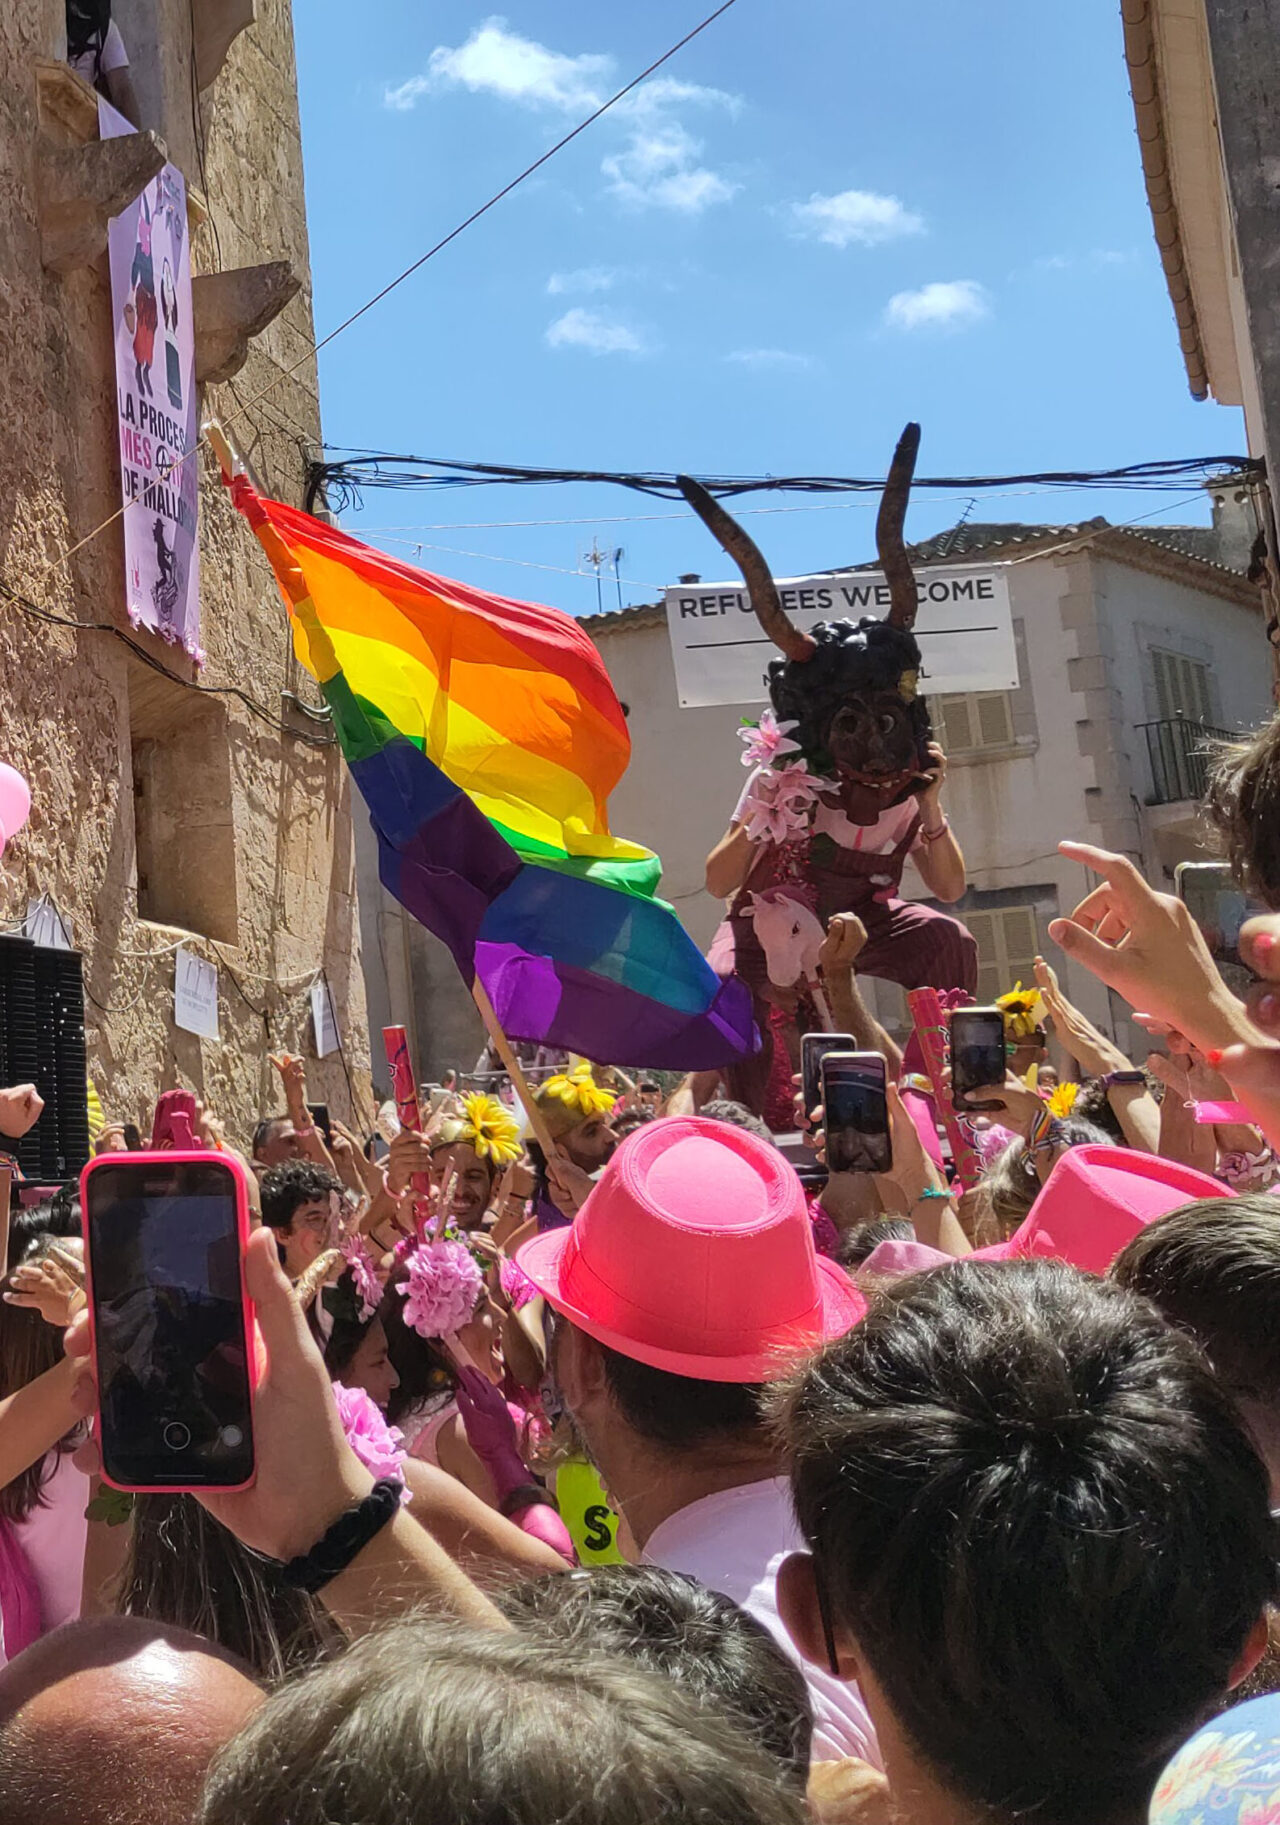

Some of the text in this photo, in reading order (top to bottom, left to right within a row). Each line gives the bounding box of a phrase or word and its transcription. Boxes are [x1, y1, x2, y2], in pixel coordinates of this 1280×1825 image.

[119, 387, 136, 426] LA
[121, 423, 152, 471] MÉS
[124, 466, 139, 503] DE
[678, 579, 995, 619] REFUEES WECOME
[584, 1505, 618, 1551] S
